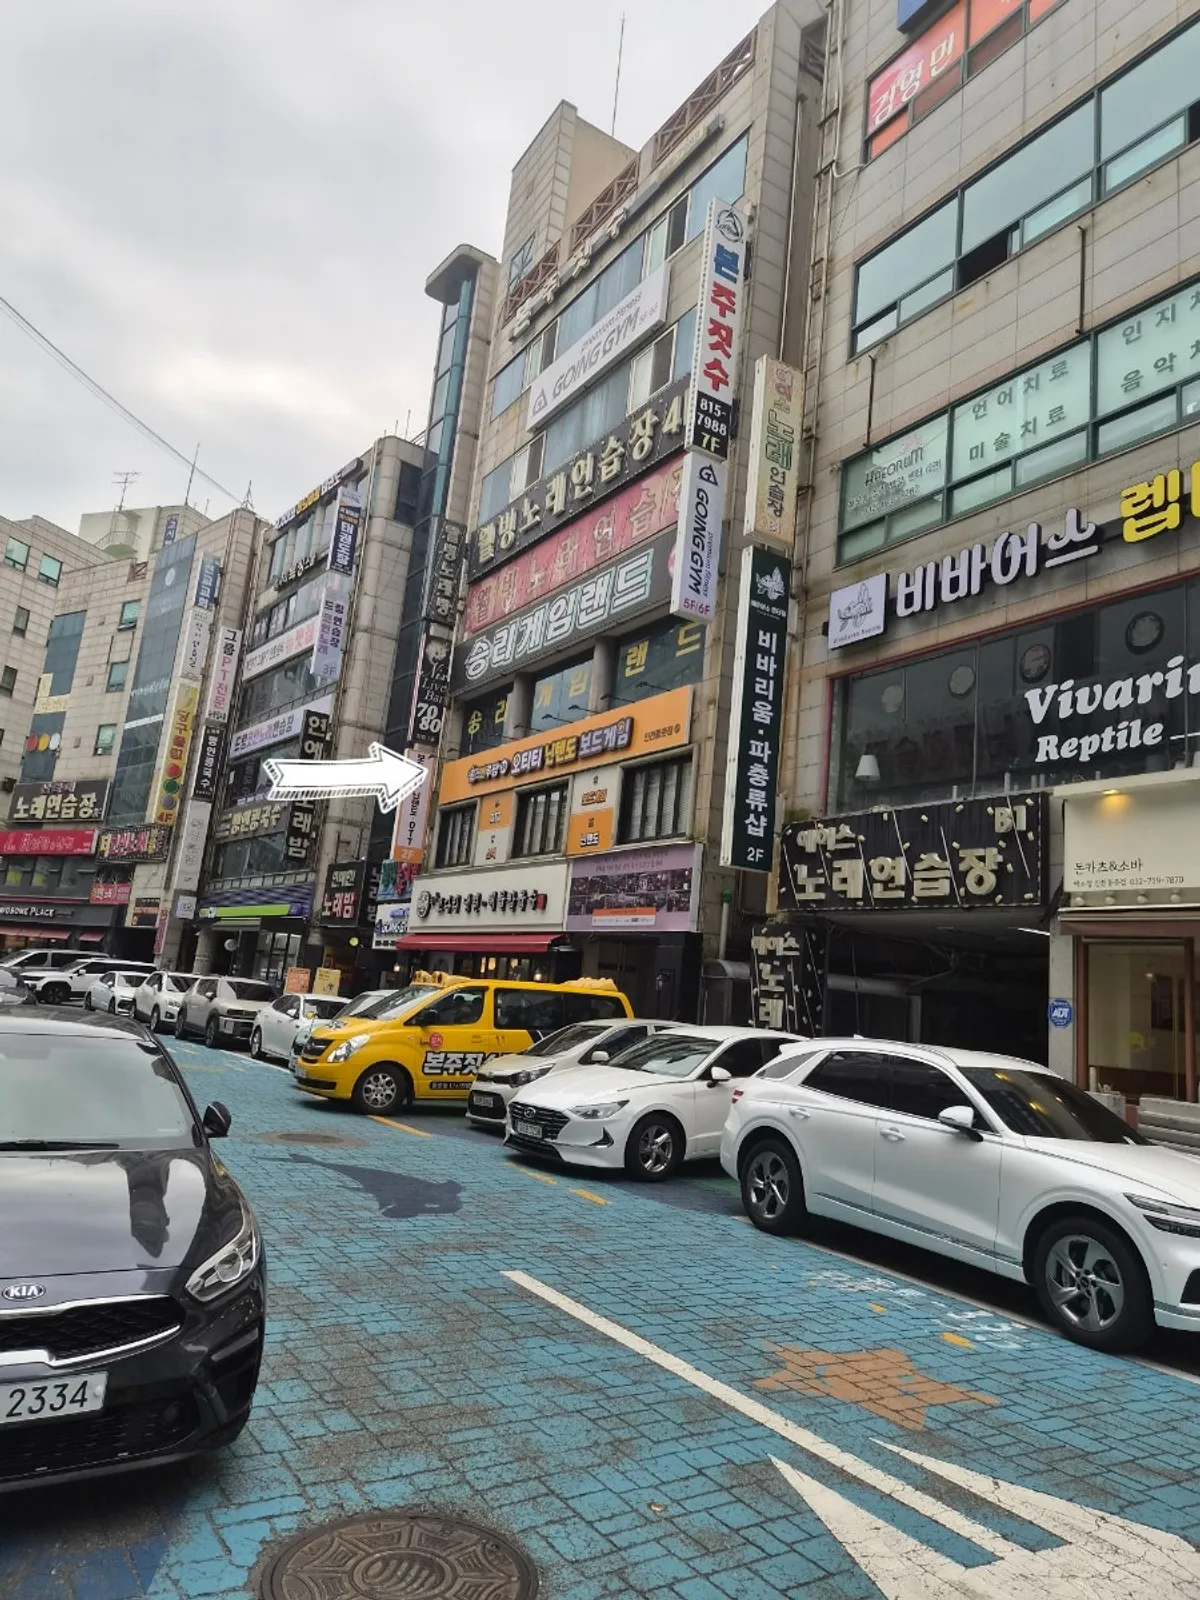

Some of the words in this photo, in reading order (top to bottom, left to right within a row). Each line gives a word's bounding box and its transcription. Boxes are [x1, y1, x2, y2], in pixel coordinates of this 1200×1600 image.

[702, 243, 741, 393] 본주짓수
[552, 342, 601, 402] GOING
[600, 306, 641, 358] GYM
[971, 360, 1069, 422] 언어치료
[699, 398, 727, 418] 815-
[697, 413, 728, 437] 7988
[968, 404, 1067, 461] 미술치료
[701, 432, 721, 454] 7F
[691, 488, 709, 550] GOING
[895, 507, 1099, 618] 비바어스
[1120, 460, 1200, 543] 렙
[688, 549, 706, 599] GYM
[465, 548, 654, 681] 승리게임랜드
[683, 598, 711, 615] 5F/6F
[322, 663, 337, 676] 3F
[416, 703, 438, 718] 70
[419, 718, 442, 733] 80
[578, 716, 632, 760] 보드게임
[1034, 719, 1164, 763] Reptile
[157, 811, 174, 822] 4F
[994, 804, 1027, 833] B1
[746, 847, 764, 862] 2F
[1074, 857, 1143, 876] 돈카츠&소바
[795, 846, 1004, 900] 노래연습장
[10, 1285, 39, 1297] KIA
[6, 1380, 89, 1418] 2334
